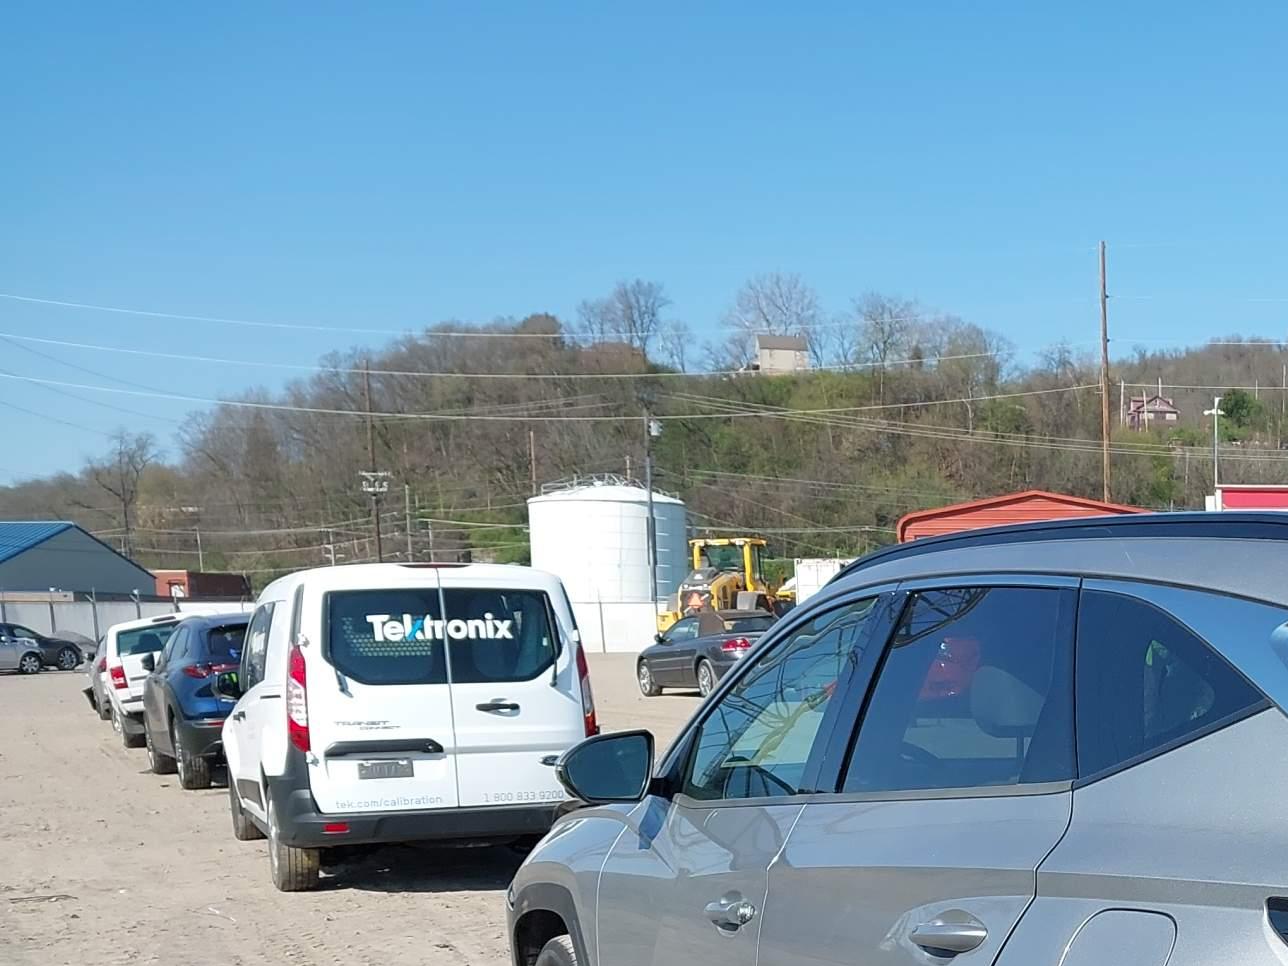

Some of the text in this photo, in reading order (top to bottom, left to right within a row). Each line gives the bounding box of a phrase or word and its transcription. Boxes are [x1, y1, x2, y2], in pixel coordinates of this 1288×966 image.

[366, 612, 514, 642] Tektronix
[335, 795, 443, 808] tek.com/calibration
[494, 792, 513, 802] 800
[516, 791, 536, 801] 833
[539, 790, 564, 800] 9200
